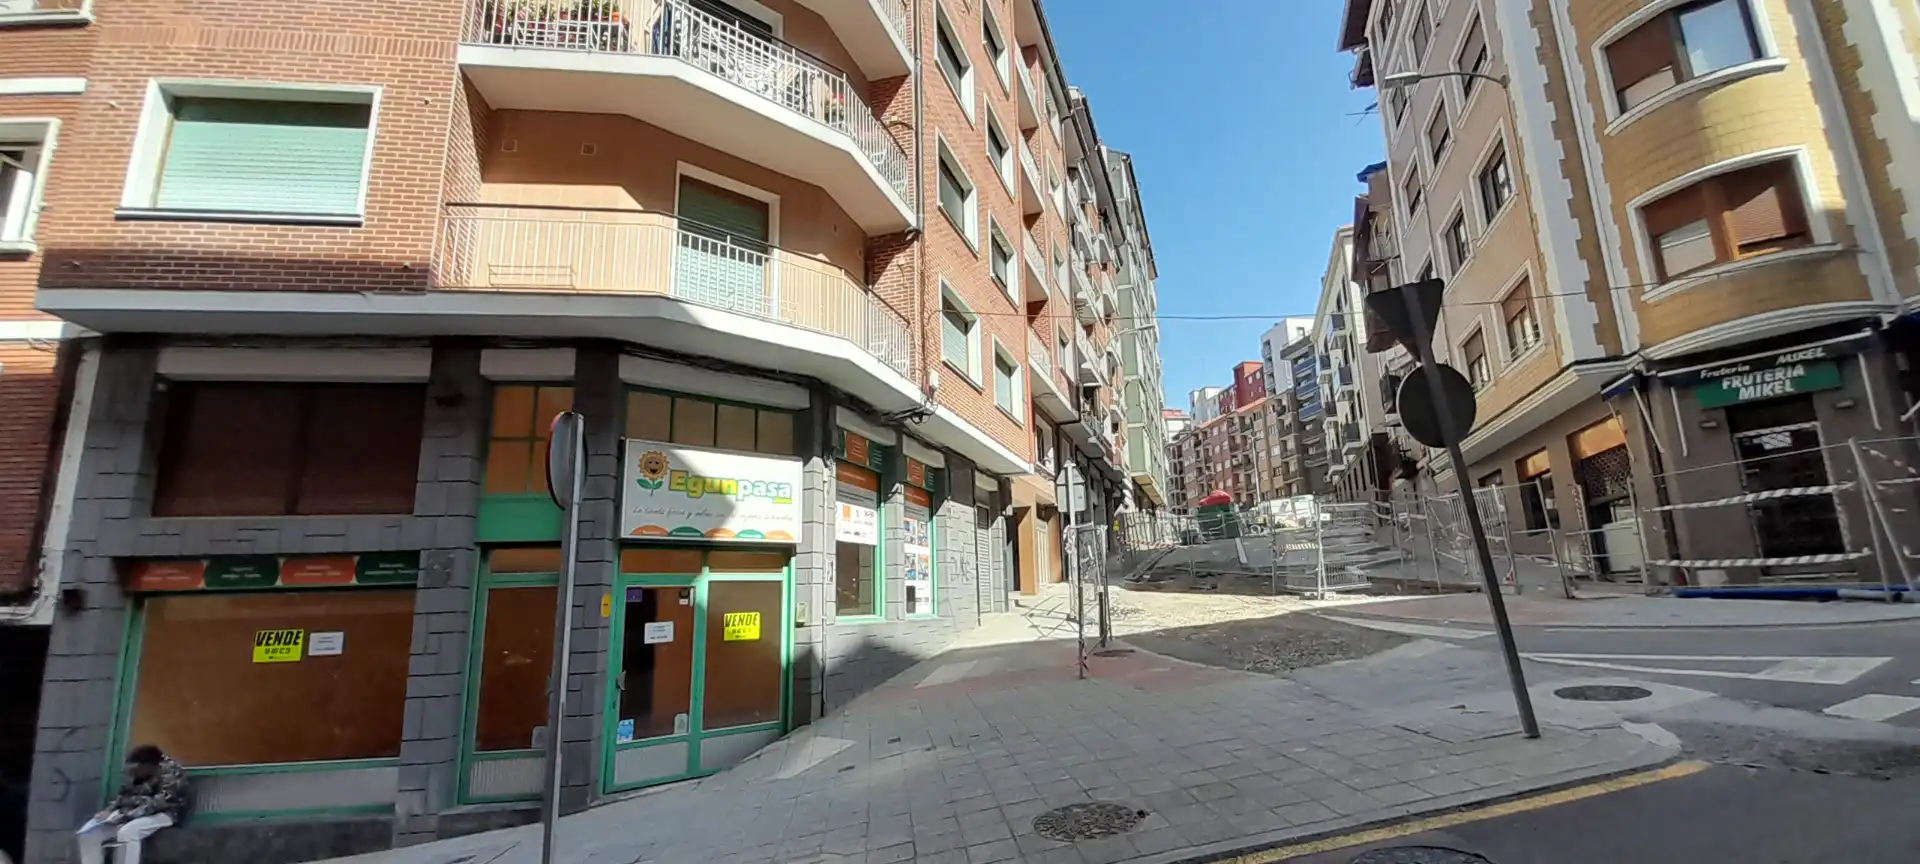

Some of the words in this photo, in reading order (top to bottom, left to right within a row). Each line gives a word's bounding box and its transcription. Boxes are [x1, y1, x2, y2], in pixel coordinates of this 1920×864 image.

[1776, 347, 1826, 365] MIKEL
[1722, 364, 1805, 390] FRUTERIA
[1739, 379, 1795, 400] MIKEL
[668, 469, 792, 502] Egunpasa
[724, 613, 759, 628] VENDE
[256, 631, 303, 647] VENDE
